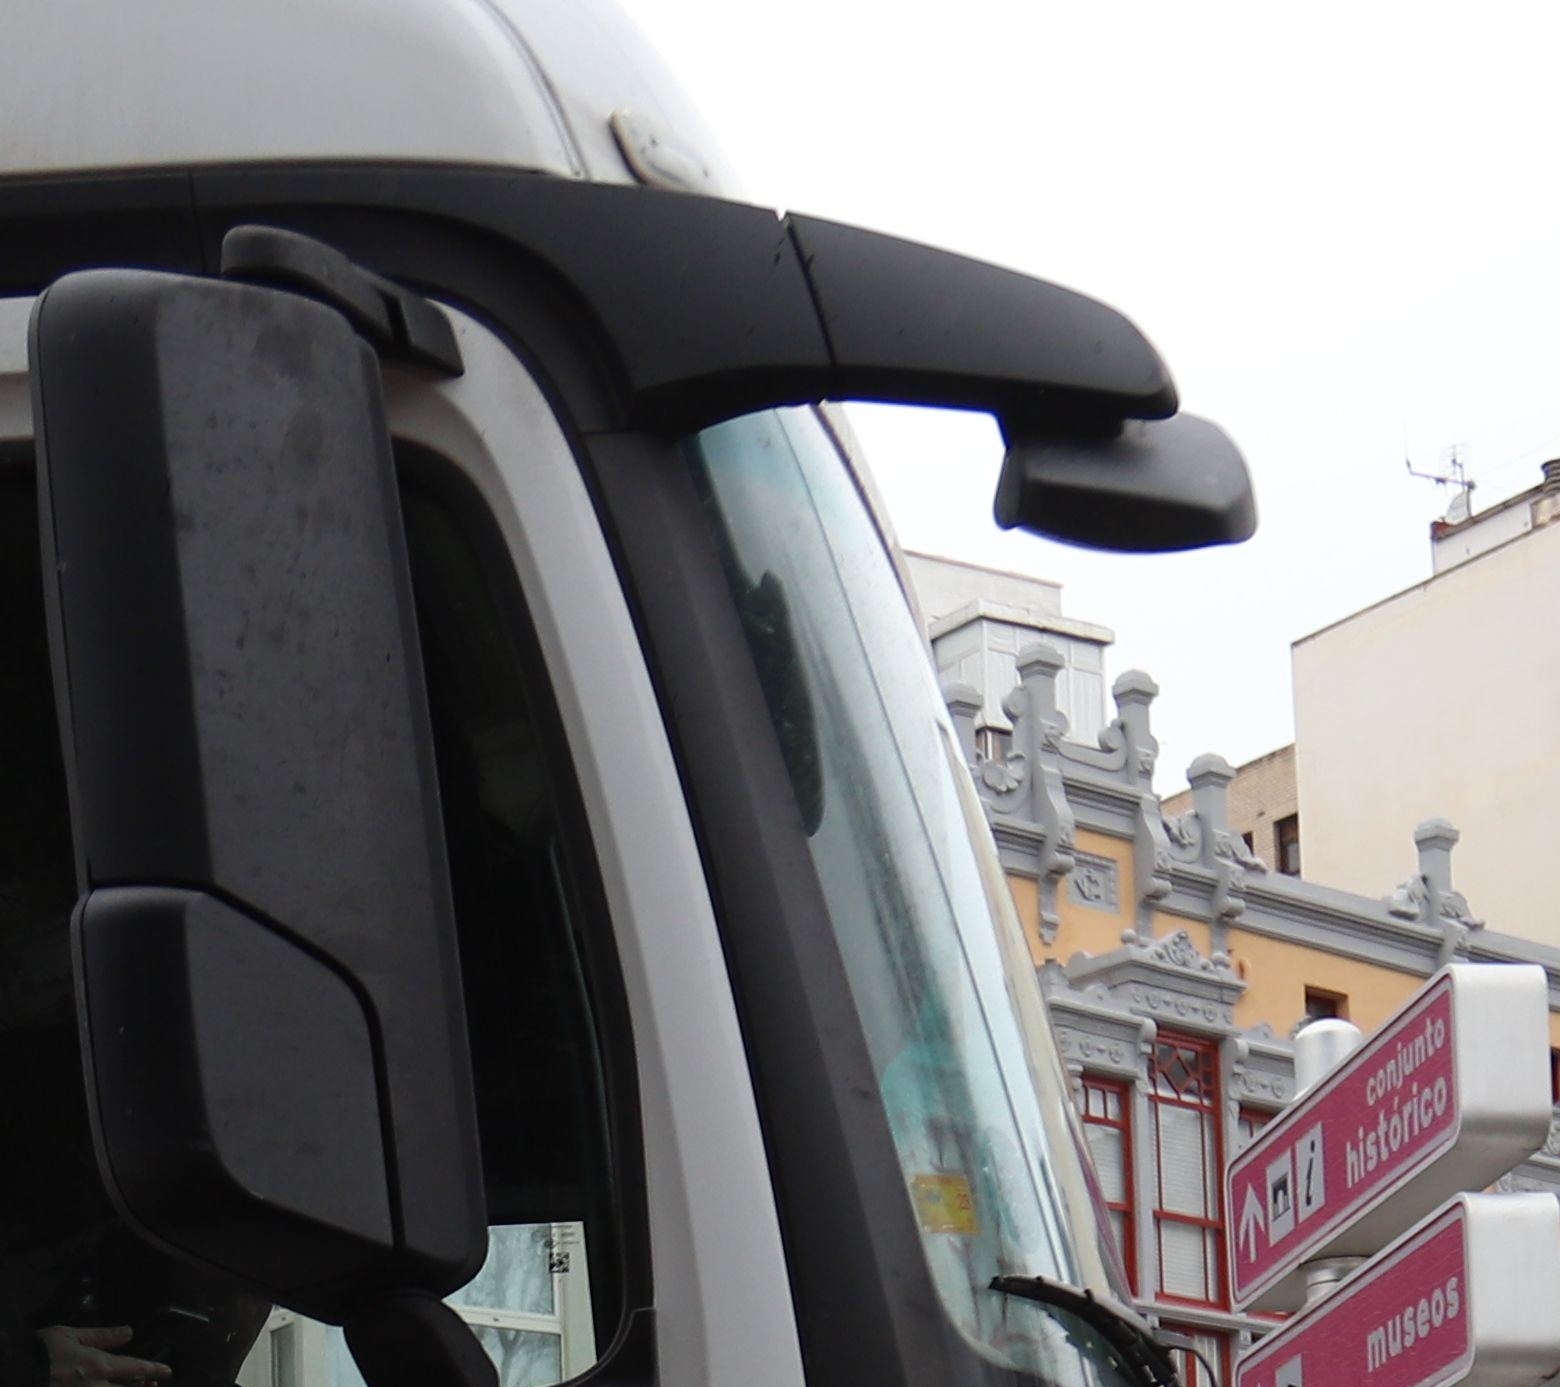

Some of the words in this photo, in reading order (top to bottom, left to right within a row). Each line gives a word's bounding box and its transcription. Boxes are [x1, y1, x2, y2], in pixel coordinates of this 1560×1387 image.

[1366, 1017, 1446, 1107] conjunto
[1345, 1076, 1448, 1190] histórico
[1366, 1276, 1460, 1374] museos
